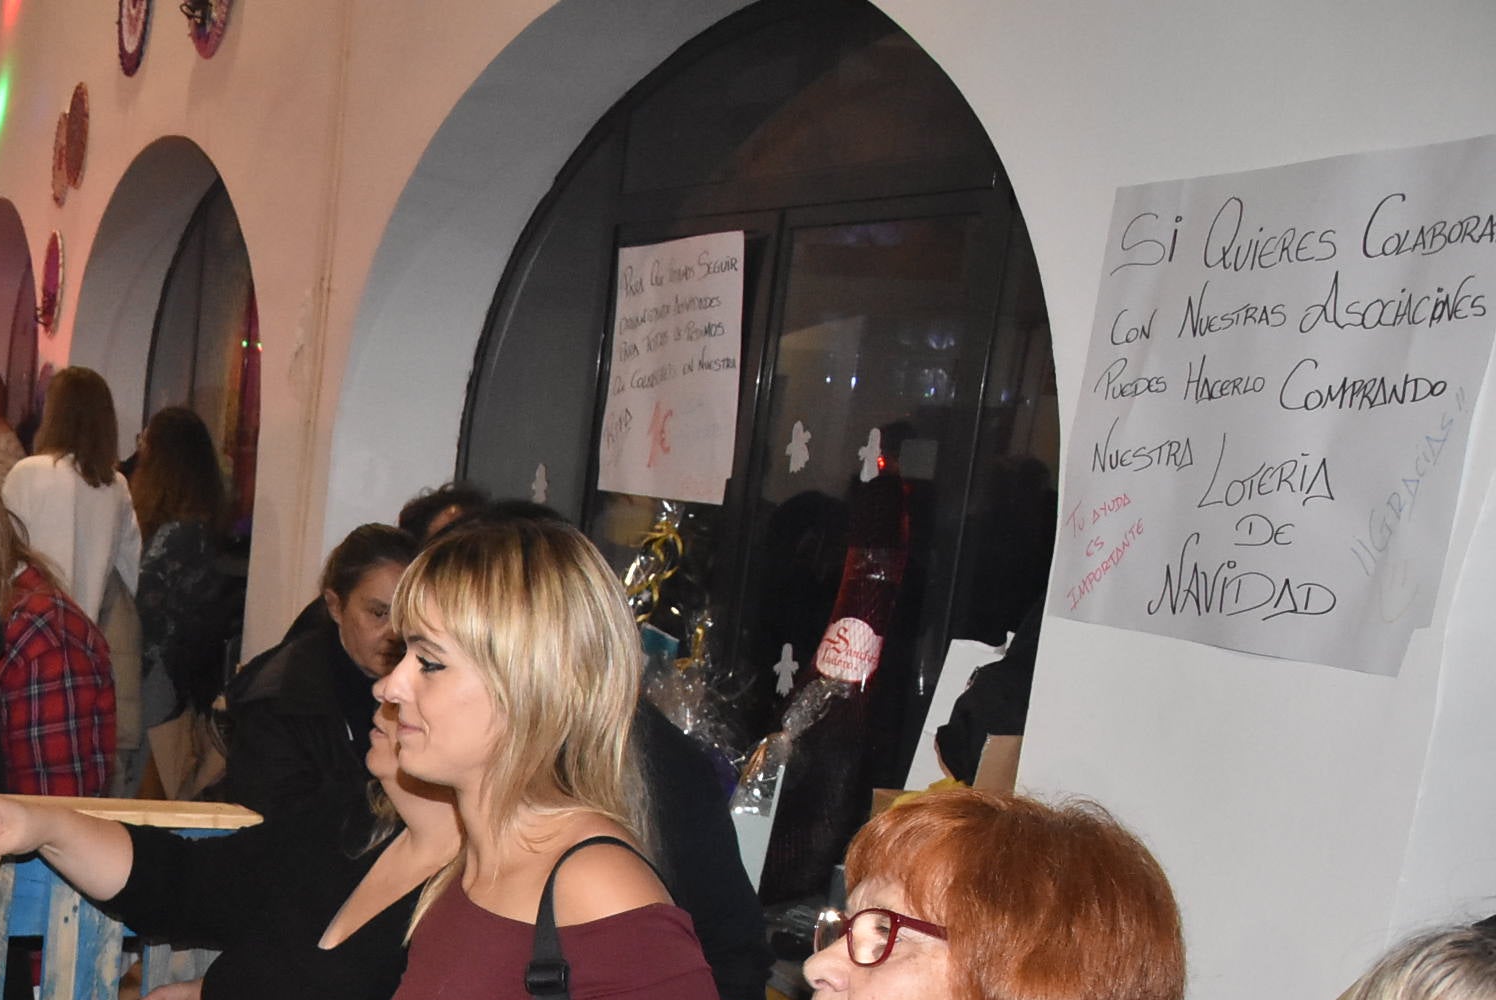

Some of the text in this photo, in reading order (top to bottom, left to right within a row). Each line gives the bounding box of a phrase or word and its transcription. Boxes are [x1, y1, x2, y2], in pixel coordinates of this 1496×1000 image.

[1204, 196, 1338, 272] QUIERES
[1363, 193, 1496, 259] COLABORA
[1110, 308, 1158, 346] CON
[1177, 280, 1288, 339] NUESTRAS
[1093, 354, 1448, 411] PUEDES HACERLO COMPRANDO
[1091, 416, 1194, 472] NUESTRA
[1196, 433, 1335, 508] LOTERIA
[1092, 493, 1132, 525] AYUDA
[1233, 513, 1296, 547] DE
[1066, 518, 1145, 613] IMPORTANTE
[1085, 536, 1106, 558] ES
[1146, 531, 1338, 621] NAVIDAD
